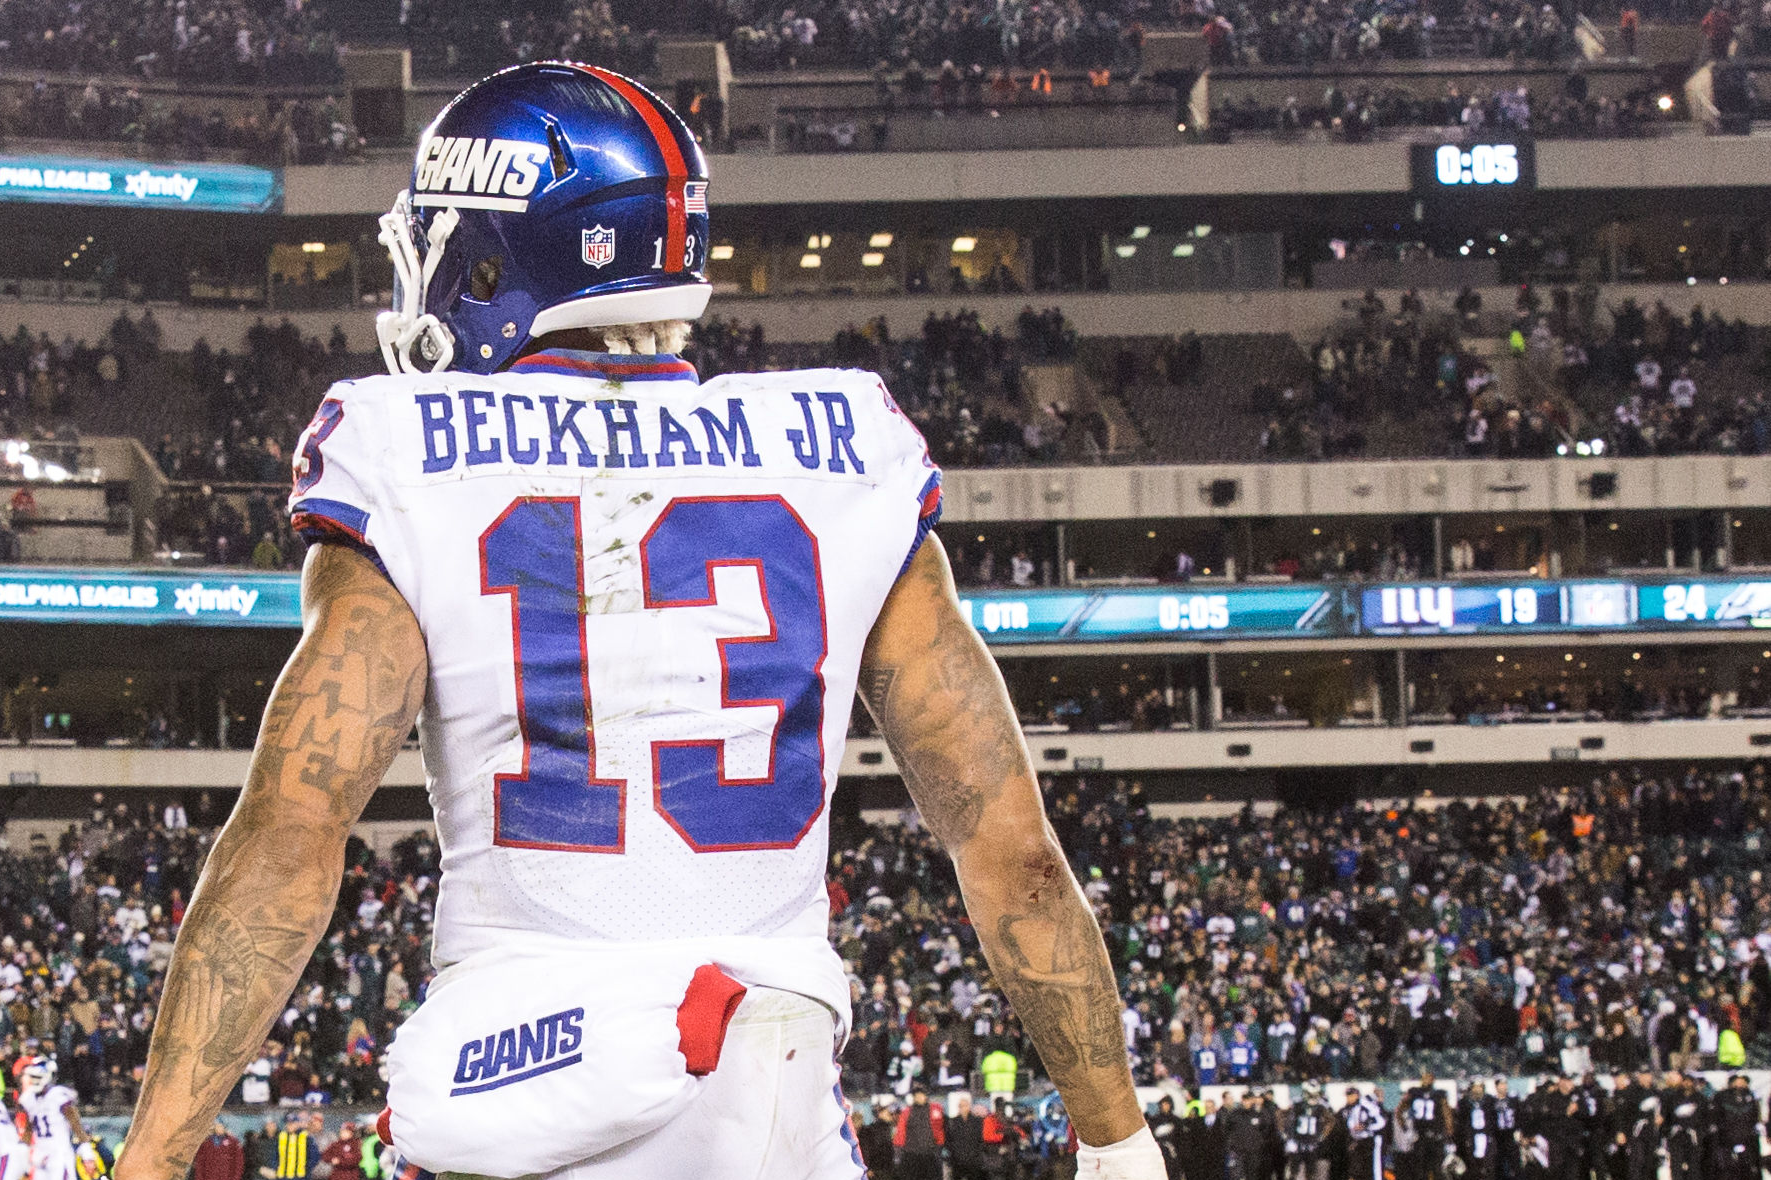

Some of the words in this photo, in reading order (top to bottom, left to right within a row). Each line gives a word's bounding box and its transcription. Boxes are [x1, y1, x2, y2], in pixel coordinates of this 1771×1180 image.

[44, 170, 111, 191] EAGLES
[415, 135, 550, 196] GIANTS
[1436, 144, 1519, 185] 0:05
[125, 170, 198, 200] xfinity
[588, 244, 611, 261] NFL
[651, 237, 663, 269] 1
[684, 235, 695, 267] 3
[414, 389, 761, 475] BECKHAM
[786, 391, 865, 475] JR
[80, 586, 158, 607] EAGLES
[174, 582, 259, 616] xfinity
[1158, 595, 1229, 631] 0:05
[1496, 588, 1538, 624] 19
[1662, 585, 1707, 621] 24
[983, 602, 1028, 633] QTR
[478, 493, 828, 855] 13
[453, 1006, 584, 1085] GIANTS
